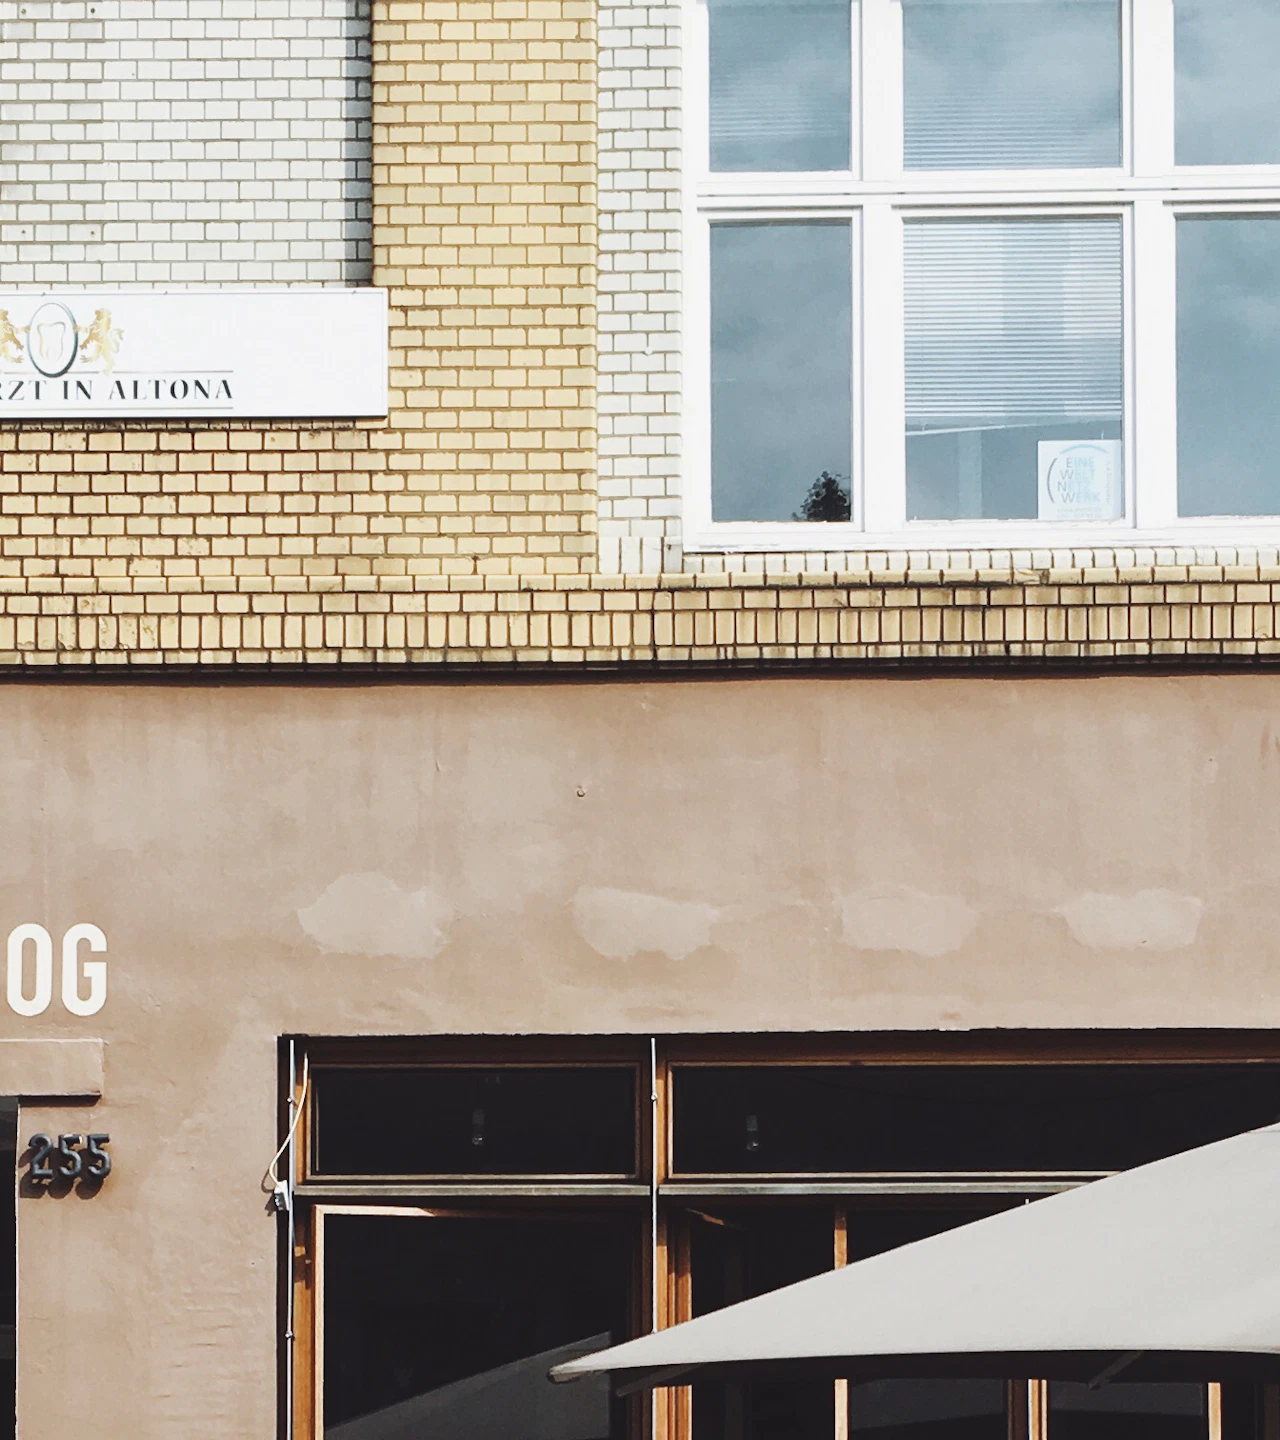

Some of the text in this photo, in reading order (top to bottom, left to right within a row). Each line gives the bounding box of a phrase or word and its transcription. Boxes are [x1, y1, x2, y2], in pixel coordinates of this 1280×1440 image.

[62, 380, 94, 400] IN
[108, 378, 234, 400] ALTONA
[26, 1132, 112, 1179] 255
